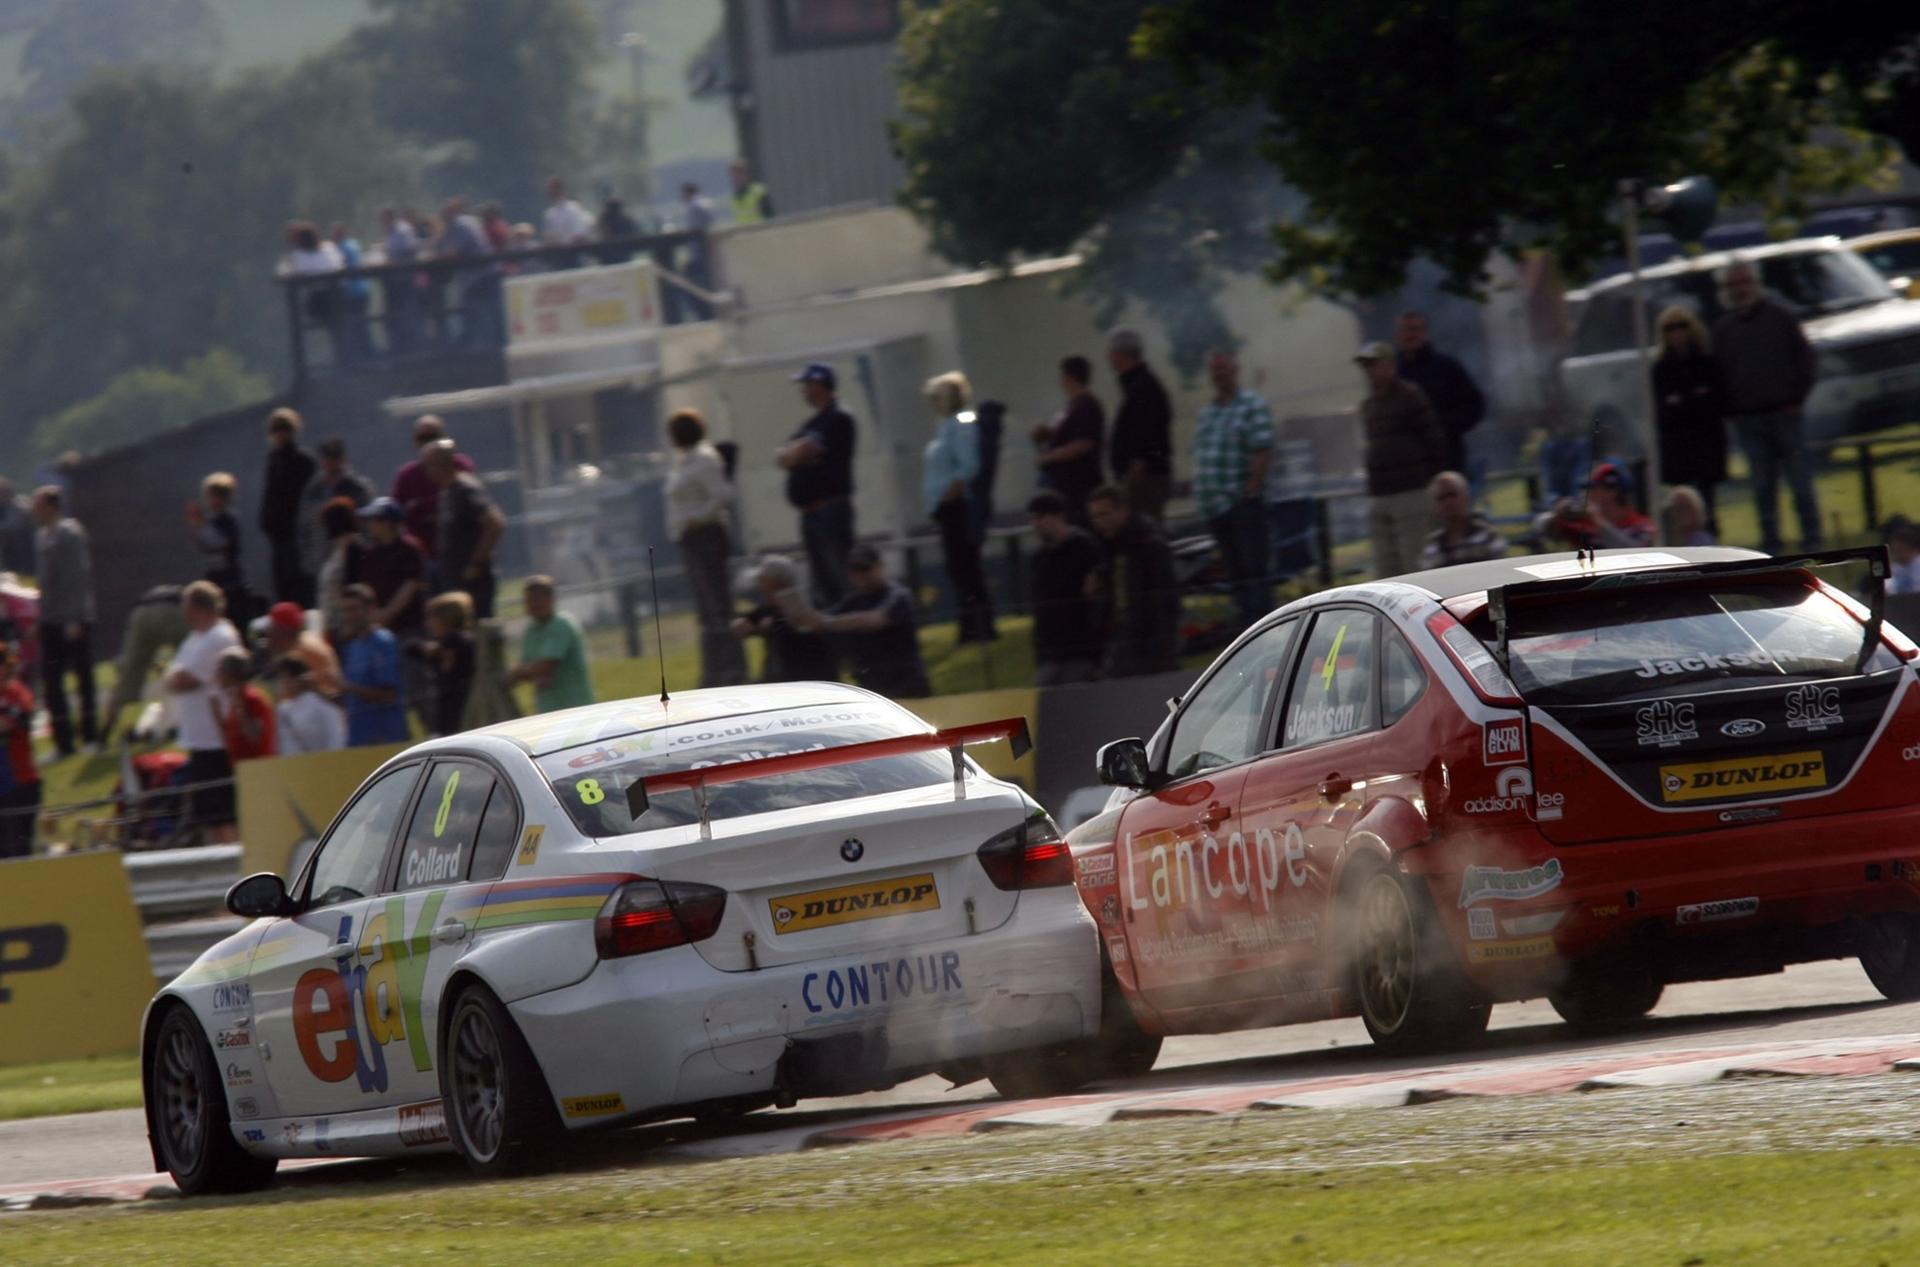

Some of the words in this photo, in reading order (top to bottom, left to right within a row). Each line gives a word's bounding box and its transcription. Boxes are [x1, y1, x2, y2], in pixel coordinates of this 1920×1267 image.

[1321, 623, 1348, 692] 4
[1634, 649, 1800, 679] Jackson
[1287, 701, 1355, 740] Jackson
[1635, 700, 1697, 738] SHC
[1786, 684, 1841, 721] SHC
[1487, 726, 1520, 741] AUTO
[1487, 739, 1521, 754] GLYM
[575, 778, 606, 806] 8
[1690, 761, 1822, 789] DUNLOP
[433, 769, 461, 839] 8
[1464, 794, 1526, 813] addison
[1536, 791, 1565, 807] lee
[406, 842, 463, 886] Collard
[1081, 871, 1116, 889] EDGE
[1124, 821, 1308, 912] Lancope
[801, 883, 934, 920] DUNLOP
[801, 949, 963, 1014] CONTOUR
